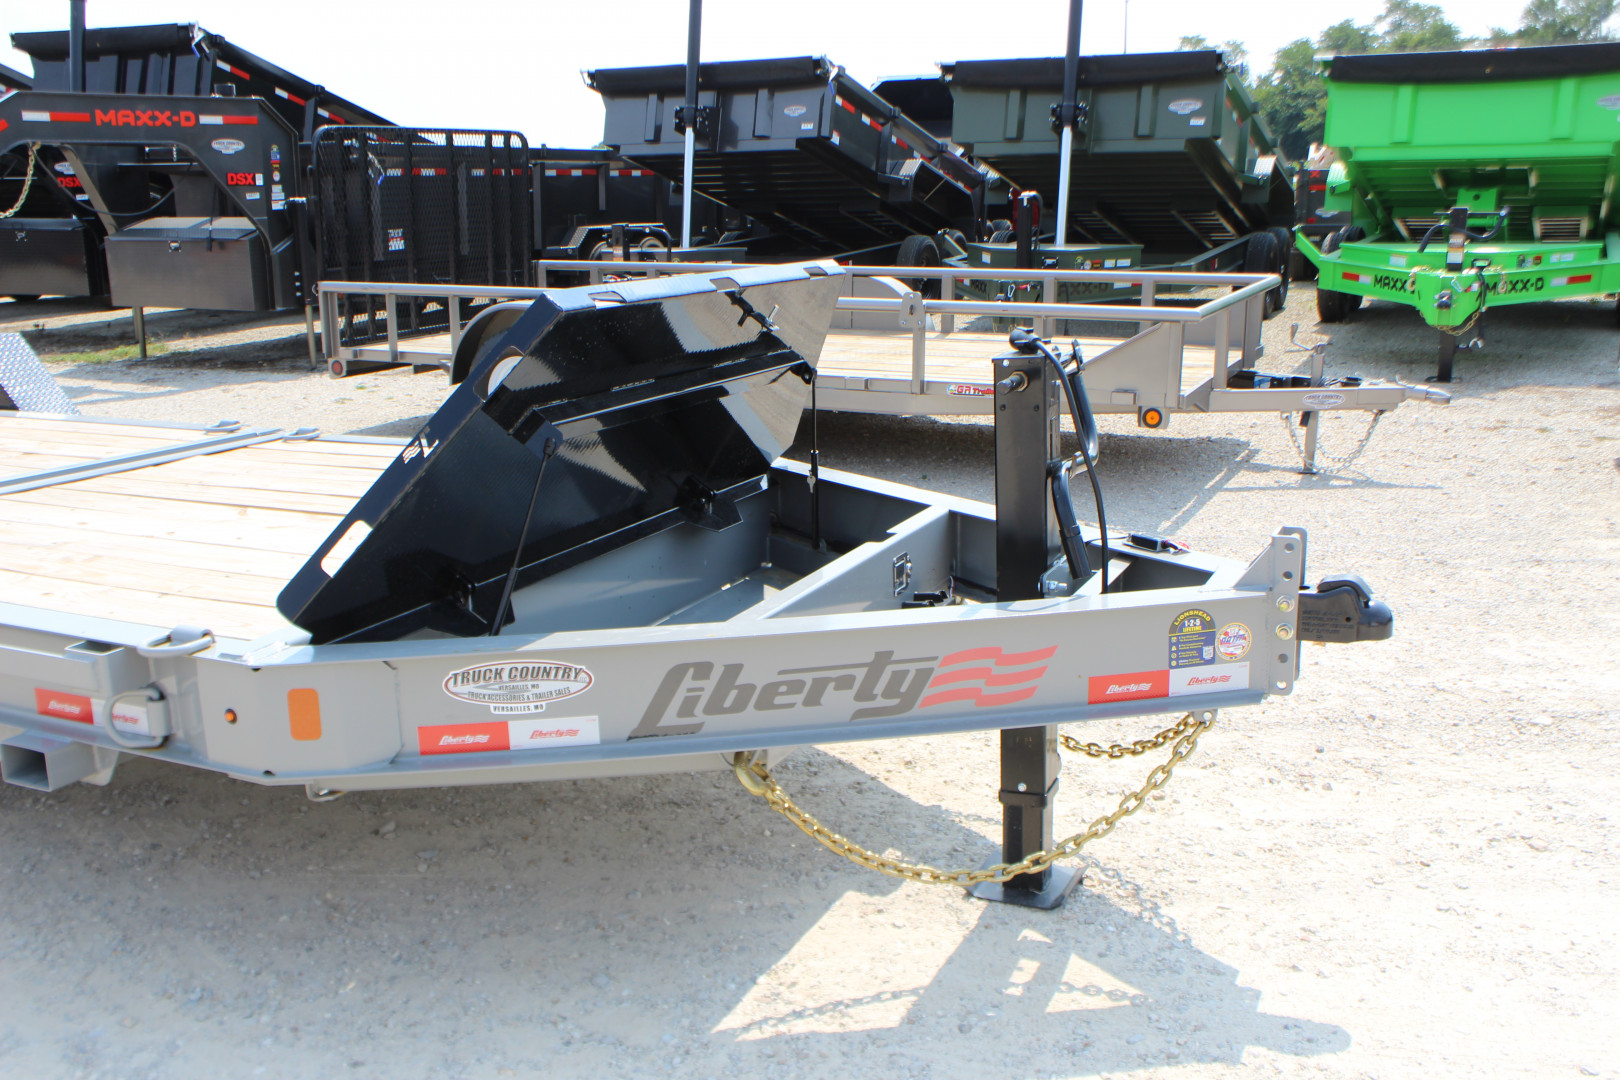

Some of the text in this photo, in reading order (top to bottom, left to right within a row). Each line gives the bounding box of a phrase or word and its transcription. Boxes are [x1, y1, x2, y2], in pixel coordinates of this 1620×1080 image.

[95, 108, 196, 127] MAXX-D
[227, 173, 255, 185] DSX
[1173, 609, 1211, 626] LIONSHEAD
[1184, 619, 1201, 627] 1-2-5
[450, 667, 505, 687] TRUCK
[508, 665, 583, 681] COUNTRY
[1186, 676, 1219, 687] Liberty
[467, 690, 487, 700] TRUCK
[487, 693, 526, 702] ACCESSORIES
[531, 690, 554, 701] TRAILER
[554, 686, 571, 697] SALES
[1105, 683, 1139, 695] Liberty
[626, 650, 939, 742] Liberty
[533, 703, 544, 712] MO
[438, 734, 476, 746] Liberty
[529, 729, 567, 740] Liberty
